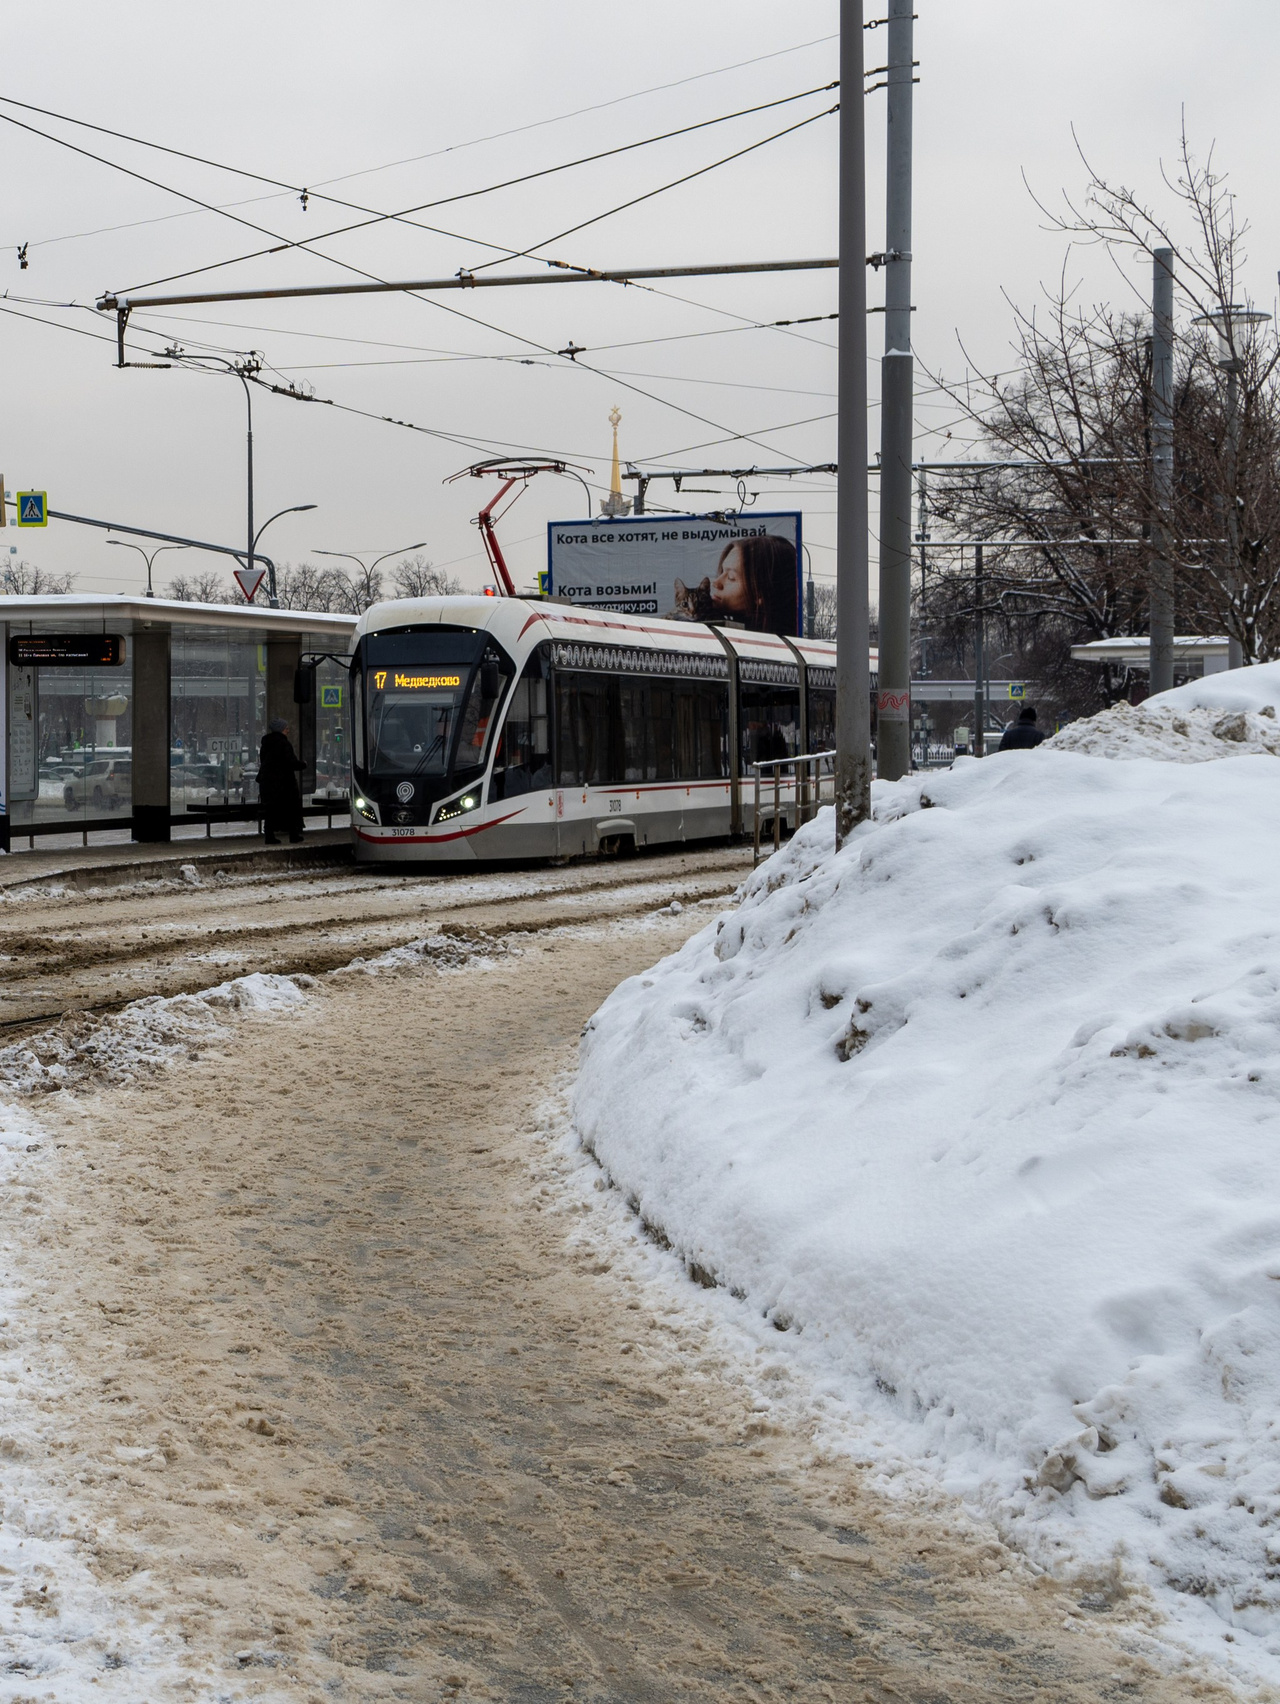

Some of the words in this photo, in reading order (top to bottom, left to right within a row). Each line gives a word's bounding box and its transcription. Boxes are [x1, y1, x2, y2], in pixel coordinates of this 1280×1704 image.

[557, 533, 587, 545] Кота
[592, 532, 614, 543] все
[618, 531, 658, 543] хотят,
[662, 531, 678, 541] не
[682, 525, 767, 541] выдумывай
[558, 585, 592, 597] Кота
[596, 582, 657, 596] возьми!
[374, 671, 387, 689] 17
[394, 673, 460, 688] Медведково
[211, 740, 238, 751] СТОП
[392, 828, 415, 836] 31078
